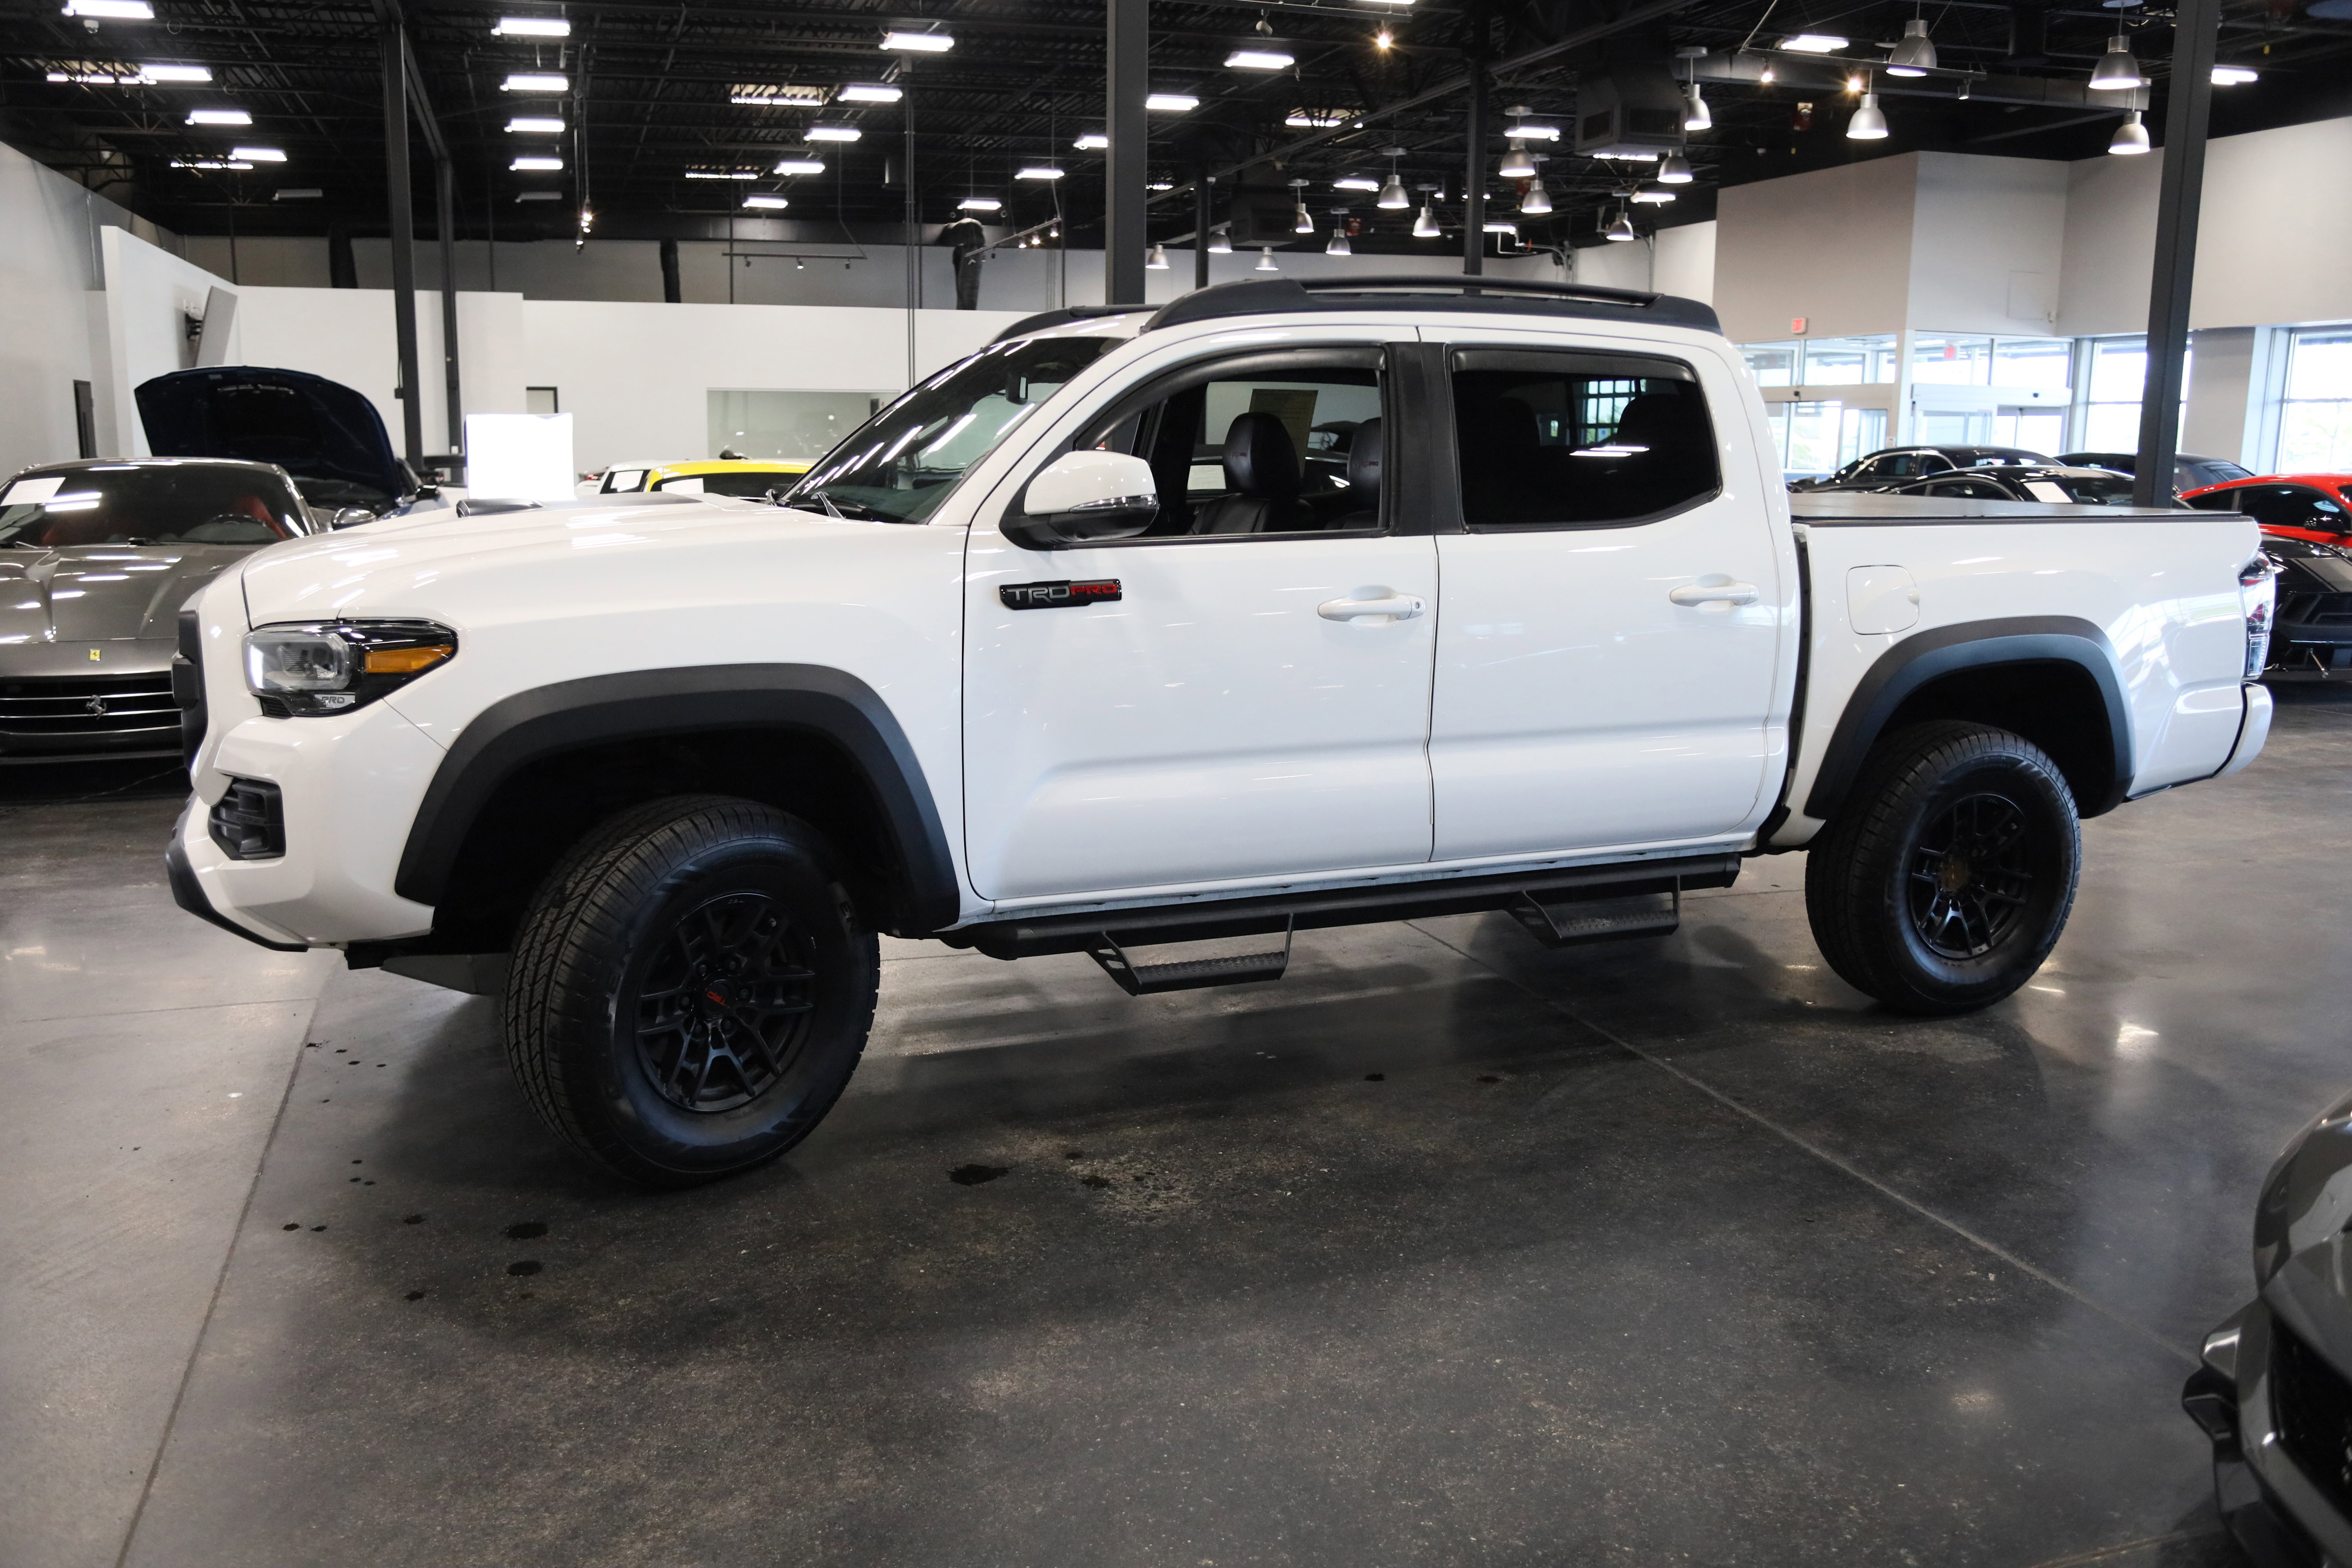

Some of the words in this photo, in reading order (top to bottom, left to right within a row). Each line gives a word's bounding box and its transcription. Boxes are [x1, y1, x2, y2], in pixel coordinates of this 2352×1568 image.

[1007, 586, 1070, 604] TRD
[1070, 584, 1117, 595] PRO
[707, 991, 726, 1006] TRD
